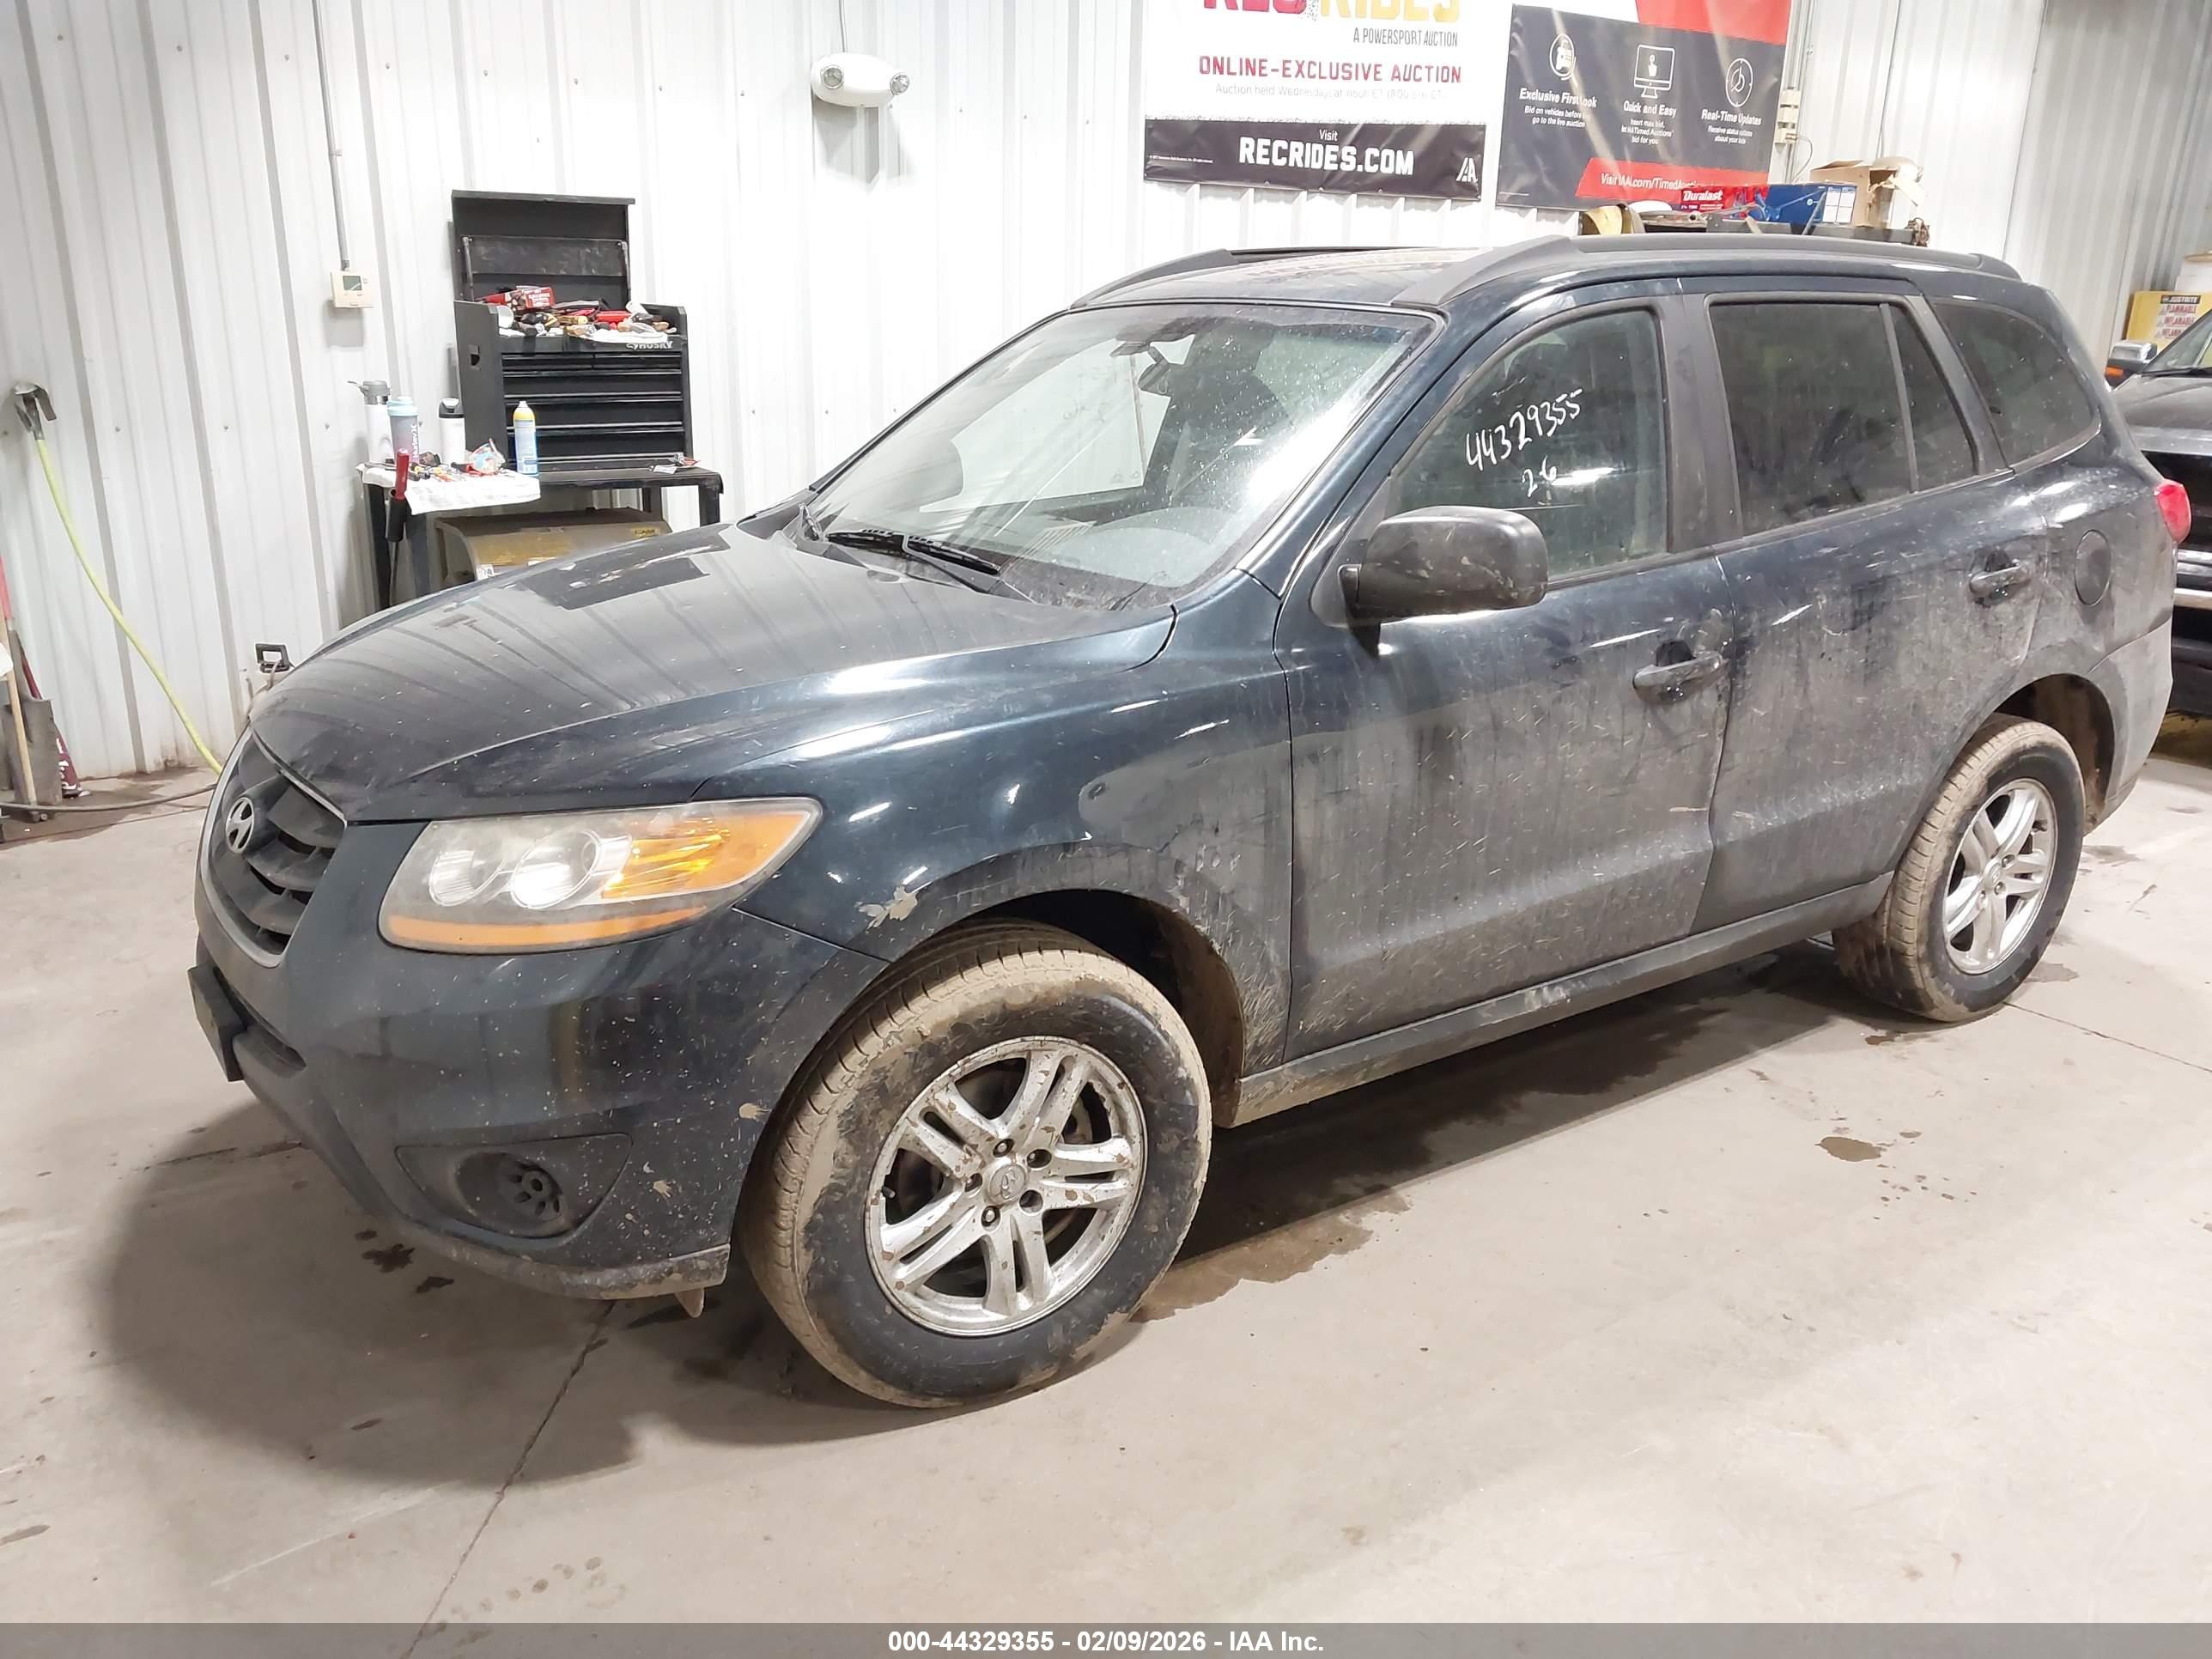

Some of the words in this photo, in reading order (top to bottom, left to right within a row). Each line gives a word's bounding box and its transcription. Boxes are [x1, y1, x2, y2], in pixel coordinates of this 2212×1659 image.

[1353, 27, 1359, 43] A
[1363, 27, 1422, 46] POWERSPORT
[1423, 30, 1458, 47] AUCTION
[1199, 55, 1383, 82] ONLINE-EXCLUSIVE
[1390, 64, 1462, 83] AUCTION
[1215, 83, 1252, 94] Auction
[1519, 87, 1560, 103] Exclusive
[1545, 107, 1564, 117] vehicles
[1623, 100, 1642, 112] Quick
[1643, 104, 1657, 114] and
[1658, 104, 1676, 118] Easy
[1701, 109, 1738, 123] Real-Time
[1738, 112, 1762, 126] Updates
[1319, 128, 1338, 143] Visit
[1239, 136, 1414, 175] RECRIDES.COM
[1601, 173, 1618, 185] Visit
[1682, 189, 1723, 201] Duralast
[1467, 388, 1583, 471] 44329355
